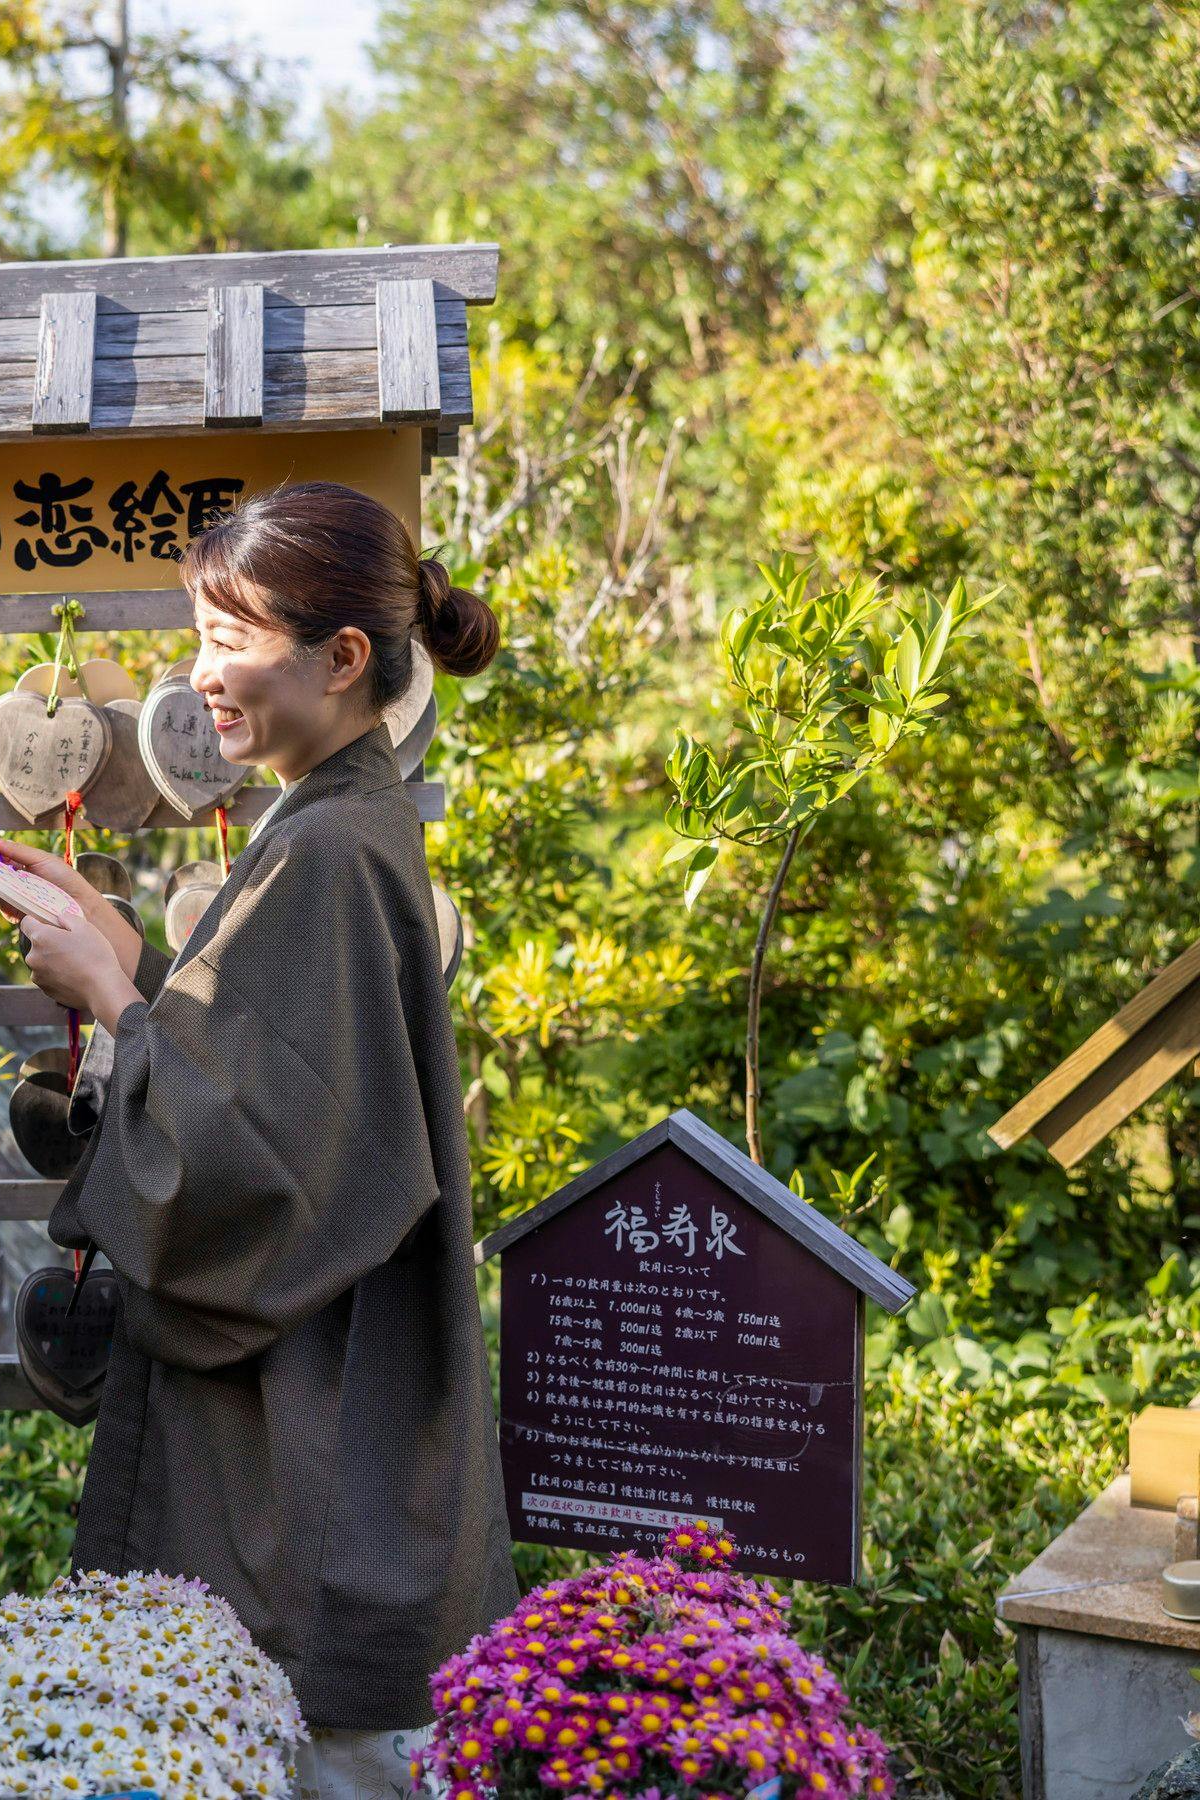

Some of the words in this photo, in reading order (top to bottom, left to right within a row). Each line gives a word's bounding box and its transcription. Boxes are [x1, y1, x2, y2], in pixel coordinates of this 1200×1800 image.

[190, 745, 222, 759] とも
[604, 1200, 747, 1260] 福寿泉
[639, 1260, 711, 1278] 飲用について
[549, 1295, 598, 1309] 16歳以上
[675, 1327, 718, 1342] 2歳以下
[550, 1412, 651, 1436] ようにして下さい。
[550, 1453, 687, 1480] つきましてご協力下さい。
[706, 1496, 756, 1514] 慢性便秘
